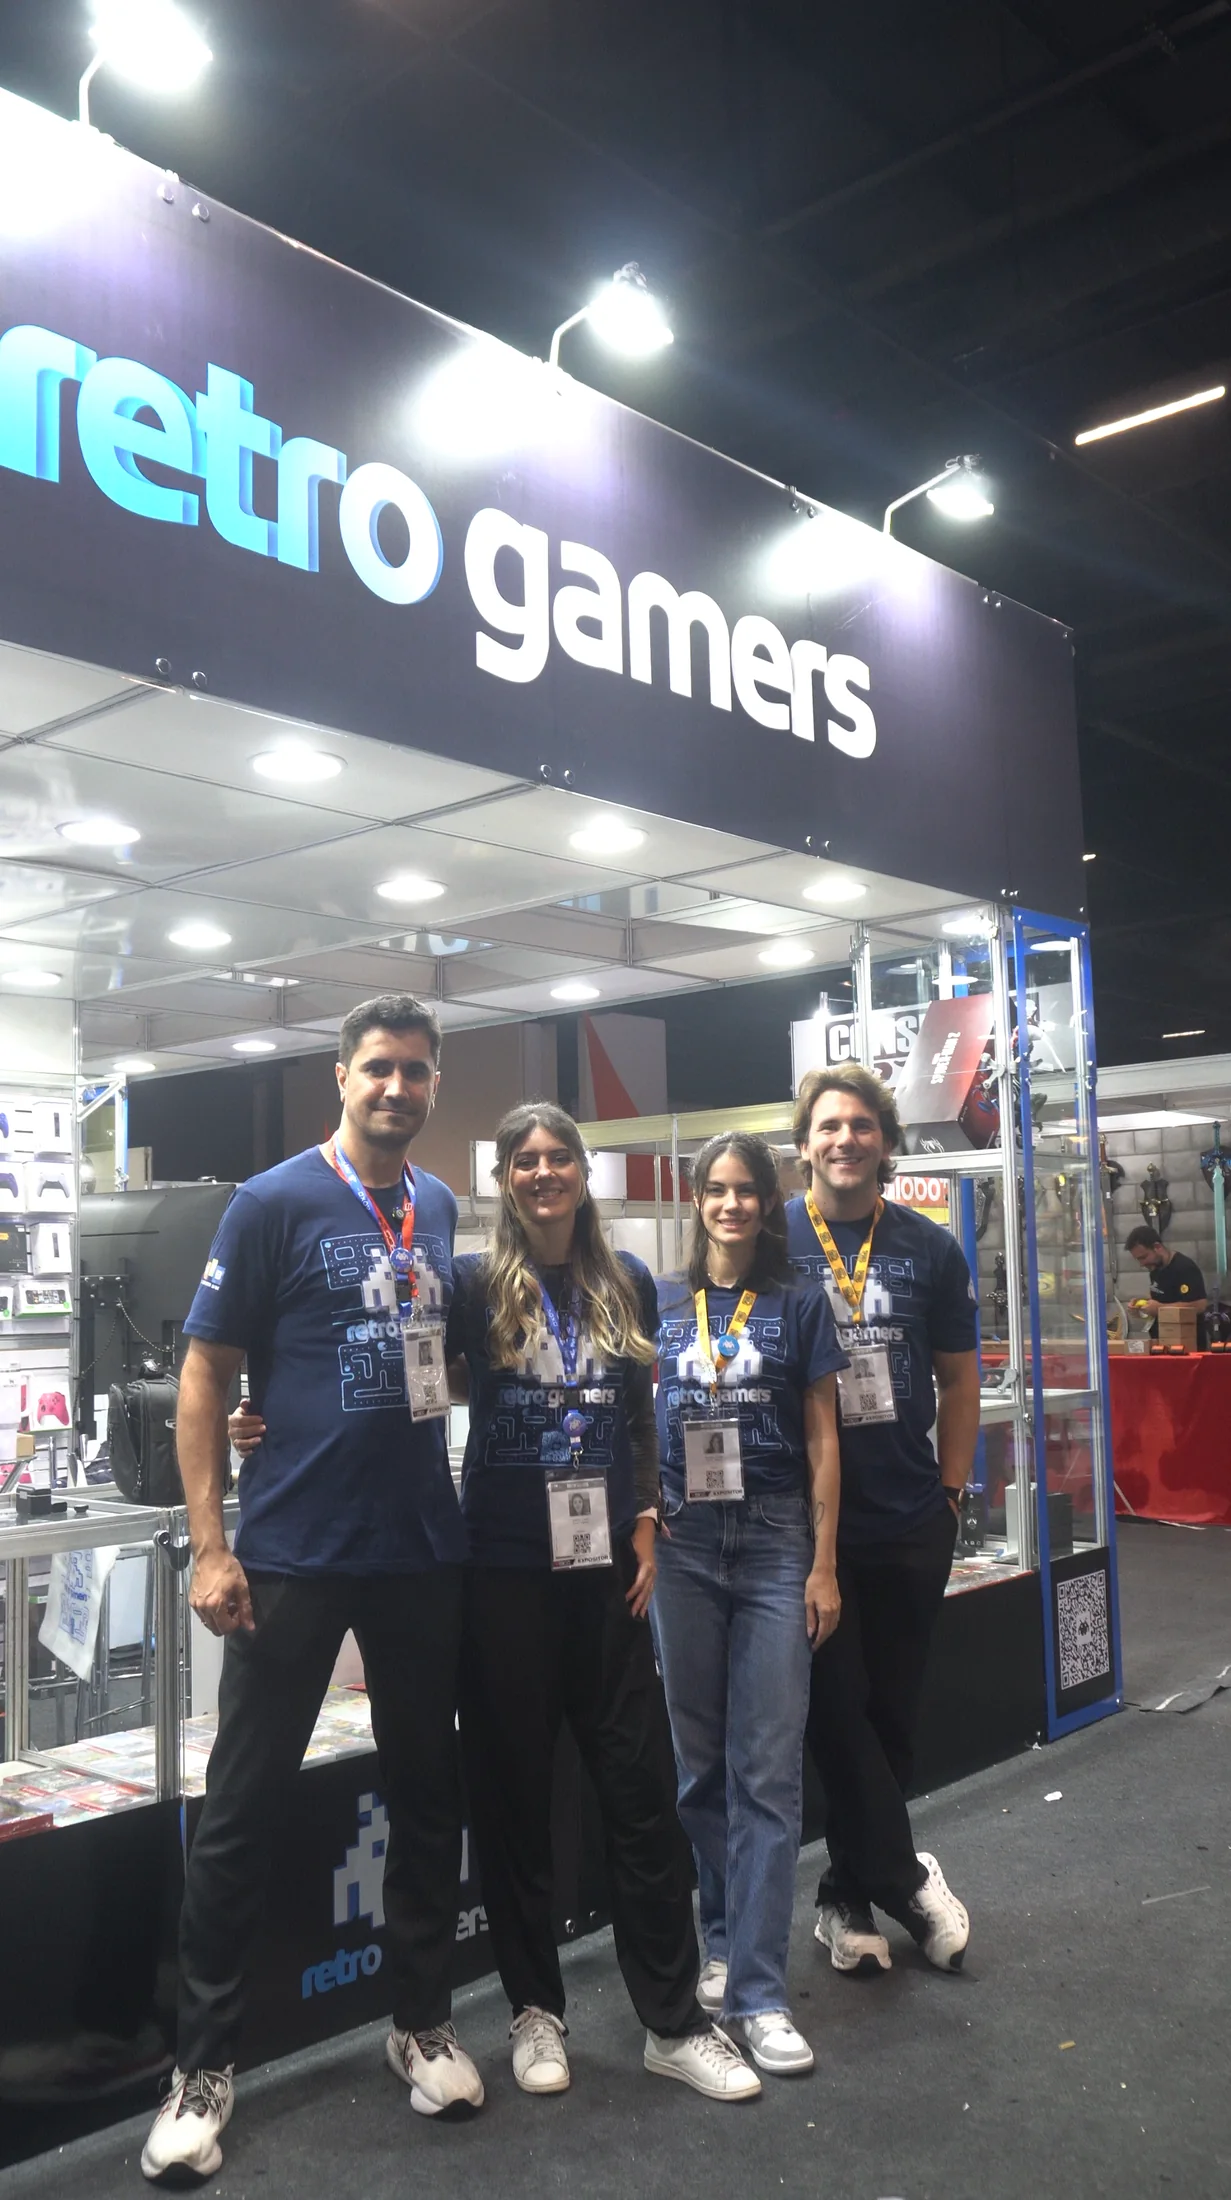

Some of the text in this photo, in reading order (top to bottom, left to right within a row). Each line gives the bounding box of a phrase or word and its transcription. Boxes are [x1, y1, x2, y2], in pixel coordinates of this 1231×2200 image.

[0, 324, 877, 758] retro gamers
[829, 1013, 925, 1061] CONS
[347, 1320, 399, 1342] retro
[667, 1387, 708, 1406] retro
[302, 1944, 382, 1999] retro
